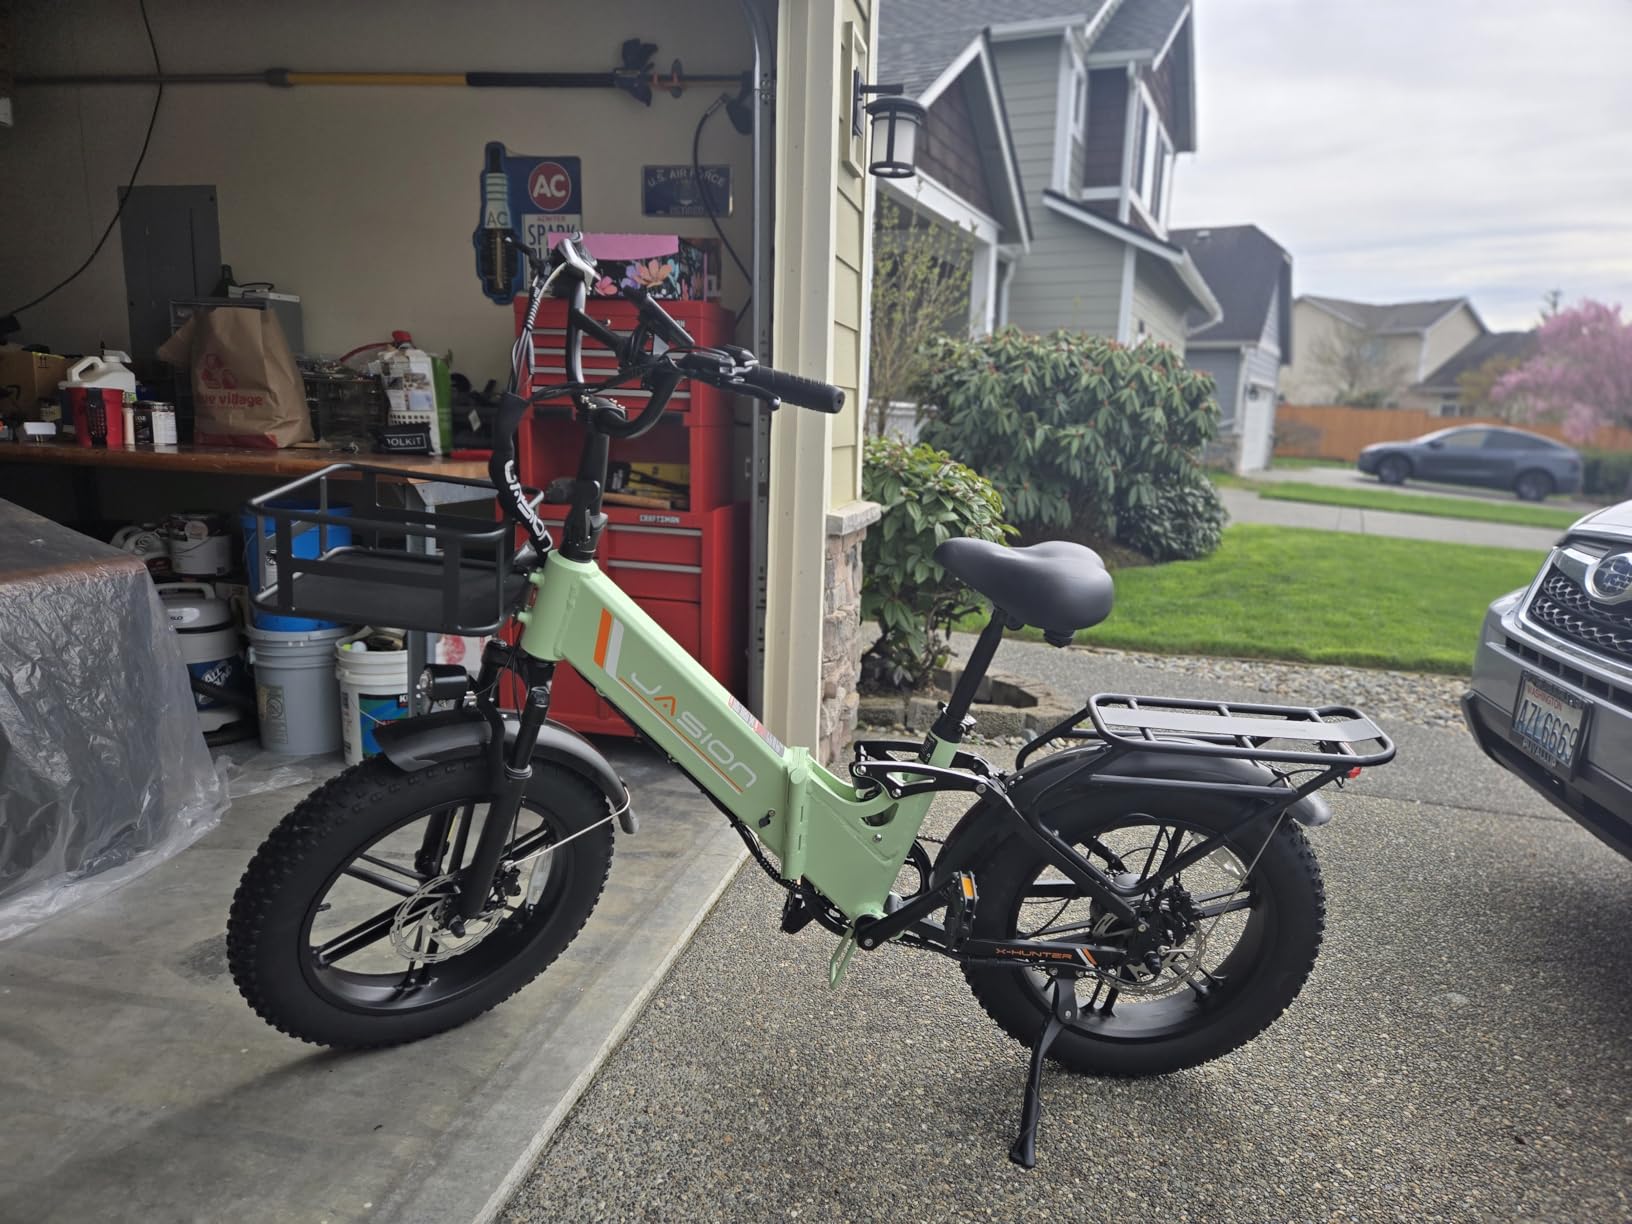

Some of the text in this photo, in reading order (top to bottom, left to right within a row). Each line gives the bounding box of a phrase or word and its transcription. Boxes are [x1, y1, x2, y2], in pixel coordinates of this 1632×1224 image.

[669, 167, 688, 179] AIR
[533, 174, 566, 198] AC
[485, 210, 509, 226] AC
[218, 392, 264, 408] village
[639, 514, 681, 524] CRAFTSMAN
[1527, 685, 1564, 712] WASHINGTON
[630, 671, 758, 788] JASION
[1516, 698, 1580, 762] AZL6669
[995, 947, 1073, 960] X-HUNTER
